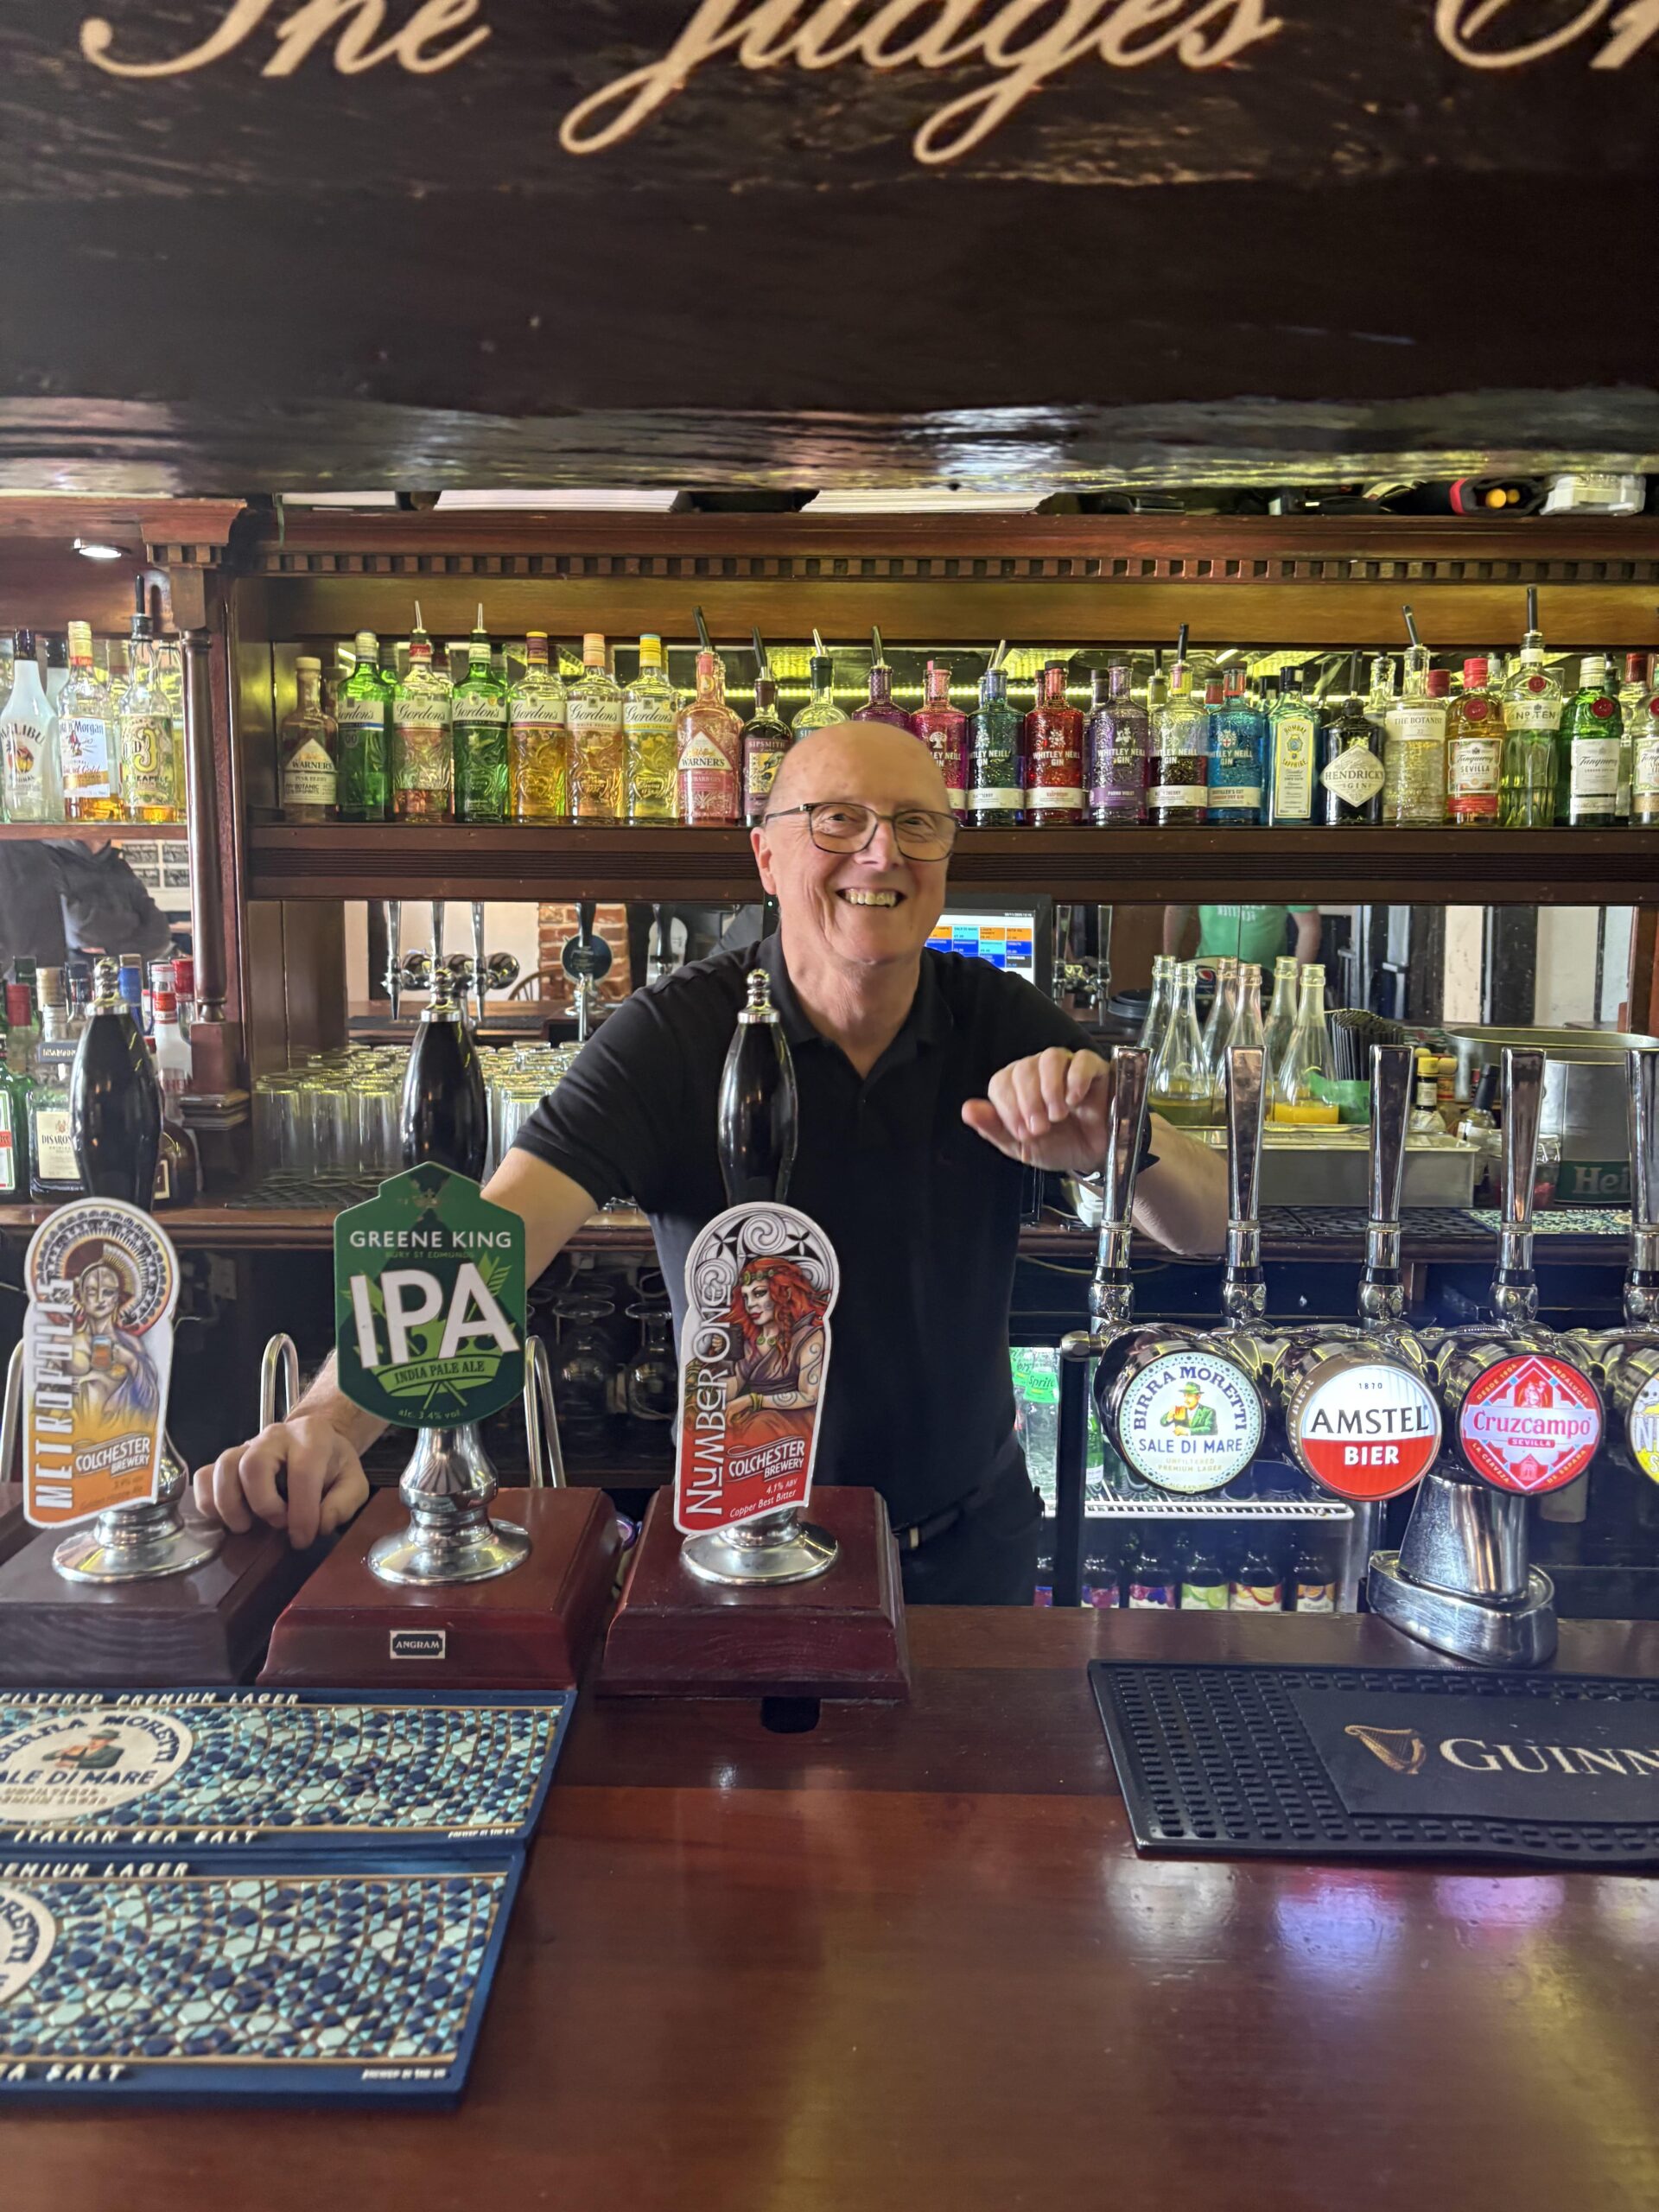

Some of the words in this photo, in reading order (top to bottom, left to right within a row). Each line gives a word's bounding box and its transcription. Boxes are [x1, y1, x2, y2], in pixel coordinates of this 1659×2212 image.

[338, 704, 375, 720] ordon's
[397, 701, 446, 721] Gordon's
[454, 700, 499, 719] Gordon's
[512, 702, 559, 720] Gordon's
[569, 702, 618, 722] Gordon's
[625, 702, 673, 723] Gordon's
[1533, 711, 1556, 720] TEN
[1409, 716, 1443, 725] BOTANIST
[1033, 750, 1064, 760] WHITLEY
[1065, 751, 1080, 760] NEILL
[1097, 748, 1129, 757] WHITLEY
[1130, 748, 1146, 757] NEILL
[1164, 756, 1178, 765] GIN
[1234, 749, 1253, 758] NEILL
[349, 1230, 442, 1248] GREENE
[452, 1230, 512, 1249] KING
[349, 1262, 522, 1369] IPA
[692, 1284, 731, 1363] ONE
[394, 1366, 428, 1384] INDIA
[429, 1362, 460, 1376] PALE
[461, 1360, 486, 1373] ALE
[1477, 1378, 1500, 1401] DESDE
[1500, 1363, 1518, 1380] 1904
[35, 1278, 74, 1510] METROPOLIS
[1134, 1370, 1177, 1431] BIRRA
[1179, 1366, 1248, 1431] MORETTI
[1309, 1404, 1429, 1435] AMSTEL
[1473, 1409, 1591, 1440] Cruzcampo
[685, 1368, 728, 1516] NUMBER
[1139, 1439, 1174, 1452] SALE
[1181, 1440, 1197, 1454] DI
[1204, 1439, 1243, 1454] MARE
[1511, 1439, 1552, 1447] SEVILLA
[75, 1437, 150, 1471] COLCHESTER
[728, 1440, 805, 1478] COLCHESTER
[1344, 1446, 1400, 1465] BIER
[1472, 1442, 1481, 1452] LA
[1482, 1452, 1510, 1484] CERVEZA
[111, 1454, 150, 1474] BREWERY
[764, 1458, 804, 1478] BREWERY
[766, 1481, 785, 1495] 4.1%
[785, 1478, 798, 1488] ABV
[1547, 1473, 1557, 1484] DE
[729, 1503, 757, 1518] Copper
[758, 1496, 774, 1509] Best
[776, 1489, 797, 1503] Bitter
[395, 1640, 441, 1649] ANGRAM
[116, 1691, 217, 1705] PREMIUM
[229, 1692, 299, 1704] LAGER
[99, 1714, 181, 1764] MORETTI
[45, 1770, 80, 1785] DI
[80, 1770, 159, 1785] MARE
[14, 1829, 119, 1844] ITALIAN
[131, 1830, 179, 1845] SEA
[194, 1829, 259, 1845] SALT
[0, 1862, 90, 1878] EMIUM
[103, 1862, 189, 1878] LAGER
[46, 2063, 126, 2082] SALT
